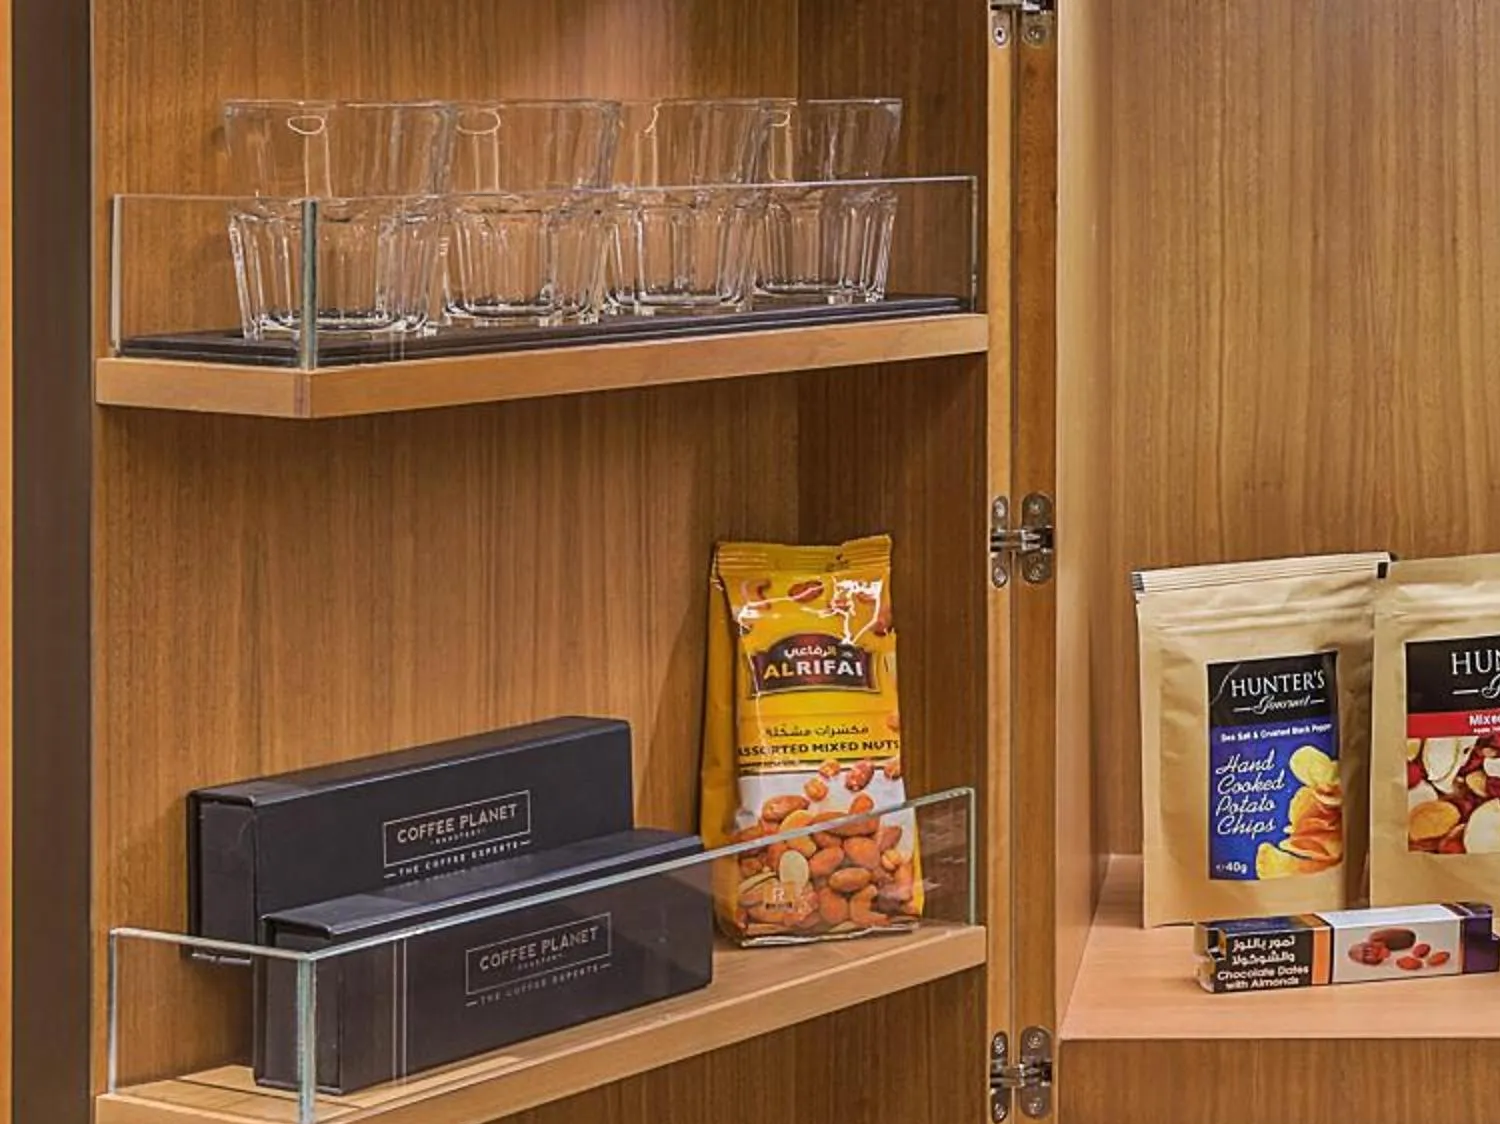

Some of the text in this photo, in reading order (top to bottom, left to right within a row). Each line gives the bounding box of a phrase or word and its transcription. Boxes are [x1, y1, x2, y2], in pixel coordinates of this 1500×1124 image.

[763, 659, 864, 680] ALRIFAI
[1231, 669, 1325, 698] HUNTER'S
[1252, 695, 1311, 715] Gourmet
[811, 741, 858, 753] MIXED
[1215, 748, 1275, 775] Hand
[1217, 769, 1285, 795] Cooked
[1215, 793, 1276, 817] Potato
[397, 803, 518, 844] COFFEE PLANET
[1217, 814, 1276, 840] Chips
[479, 926, 599, 971] COFFEE PLANET
[1217, 965, 1309, 981] Chocolate Dates
[1225, 976, 1299, 990] with Almonds
